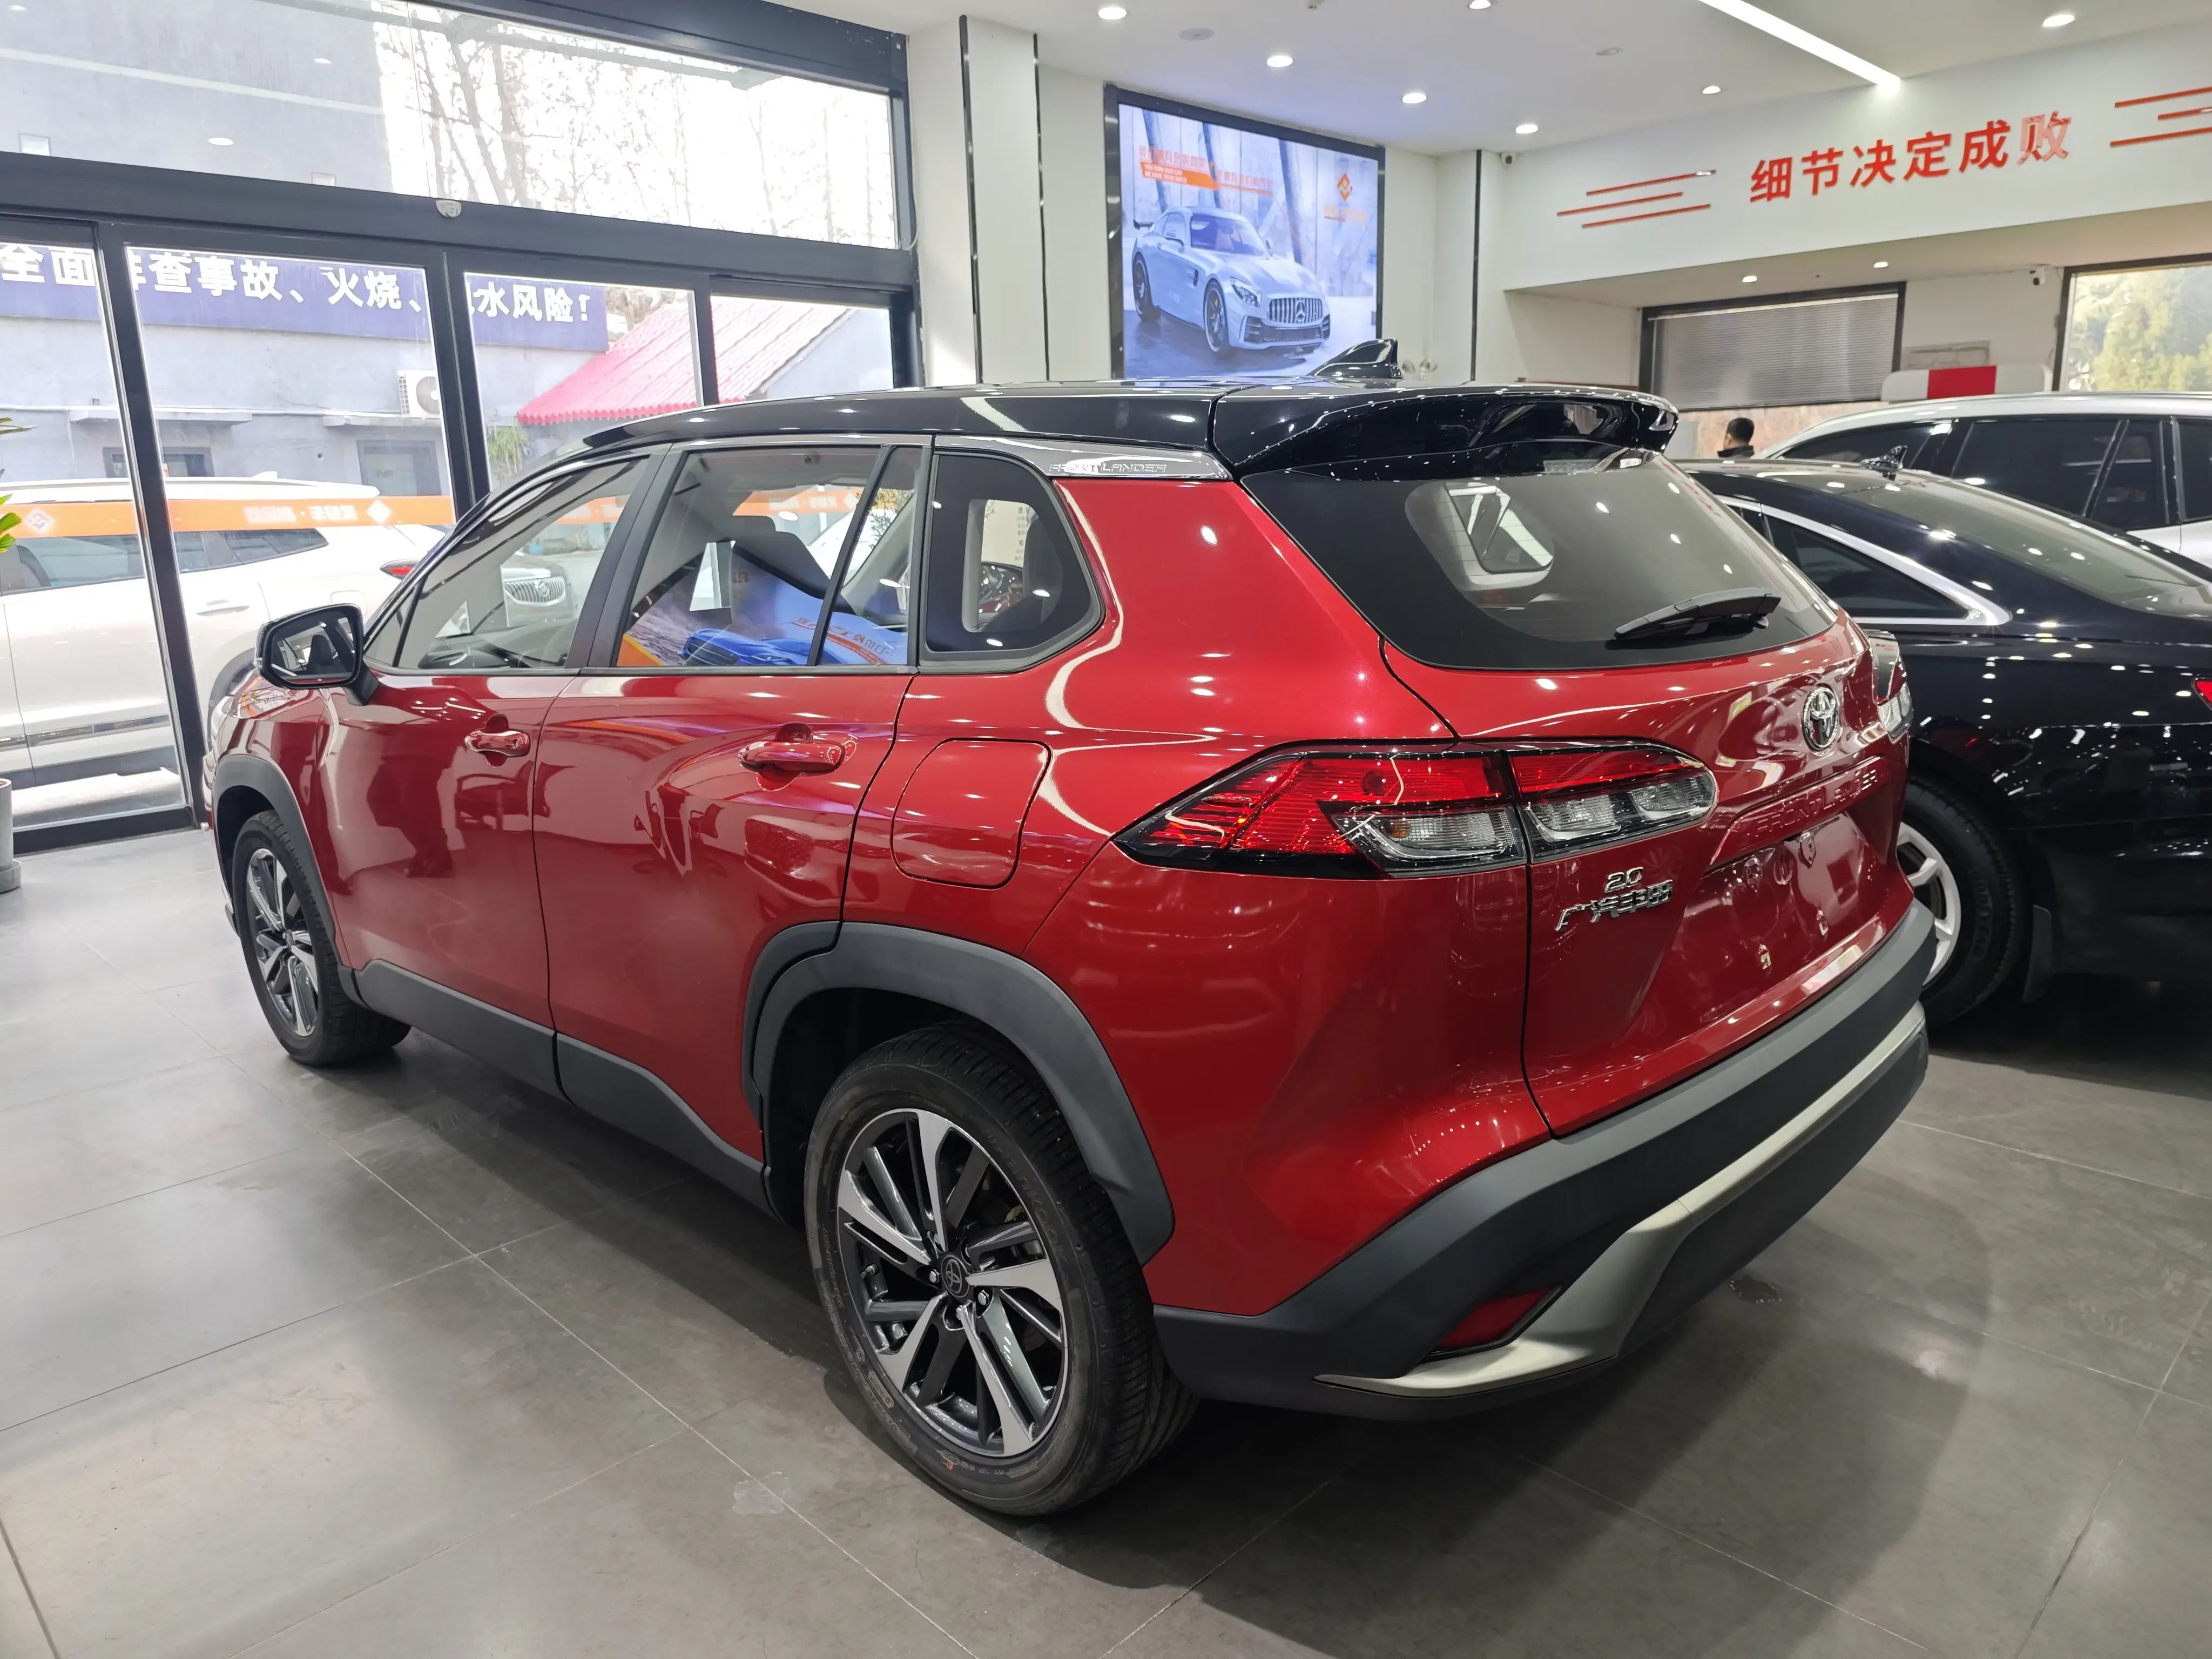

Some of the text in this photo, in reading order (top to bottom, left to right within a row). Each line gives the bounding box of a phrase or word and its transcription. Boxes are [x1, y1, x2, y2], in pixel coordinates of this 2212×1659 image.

[1750, 110, 2072, 203] 细节决定成败
[0, 244, 590, 322] 全面查事故、火烧、水风险!
[1048, 462, 1167, 474] FRONTLANDER
[1554, 879, 1673, 932] 广汽丰田
